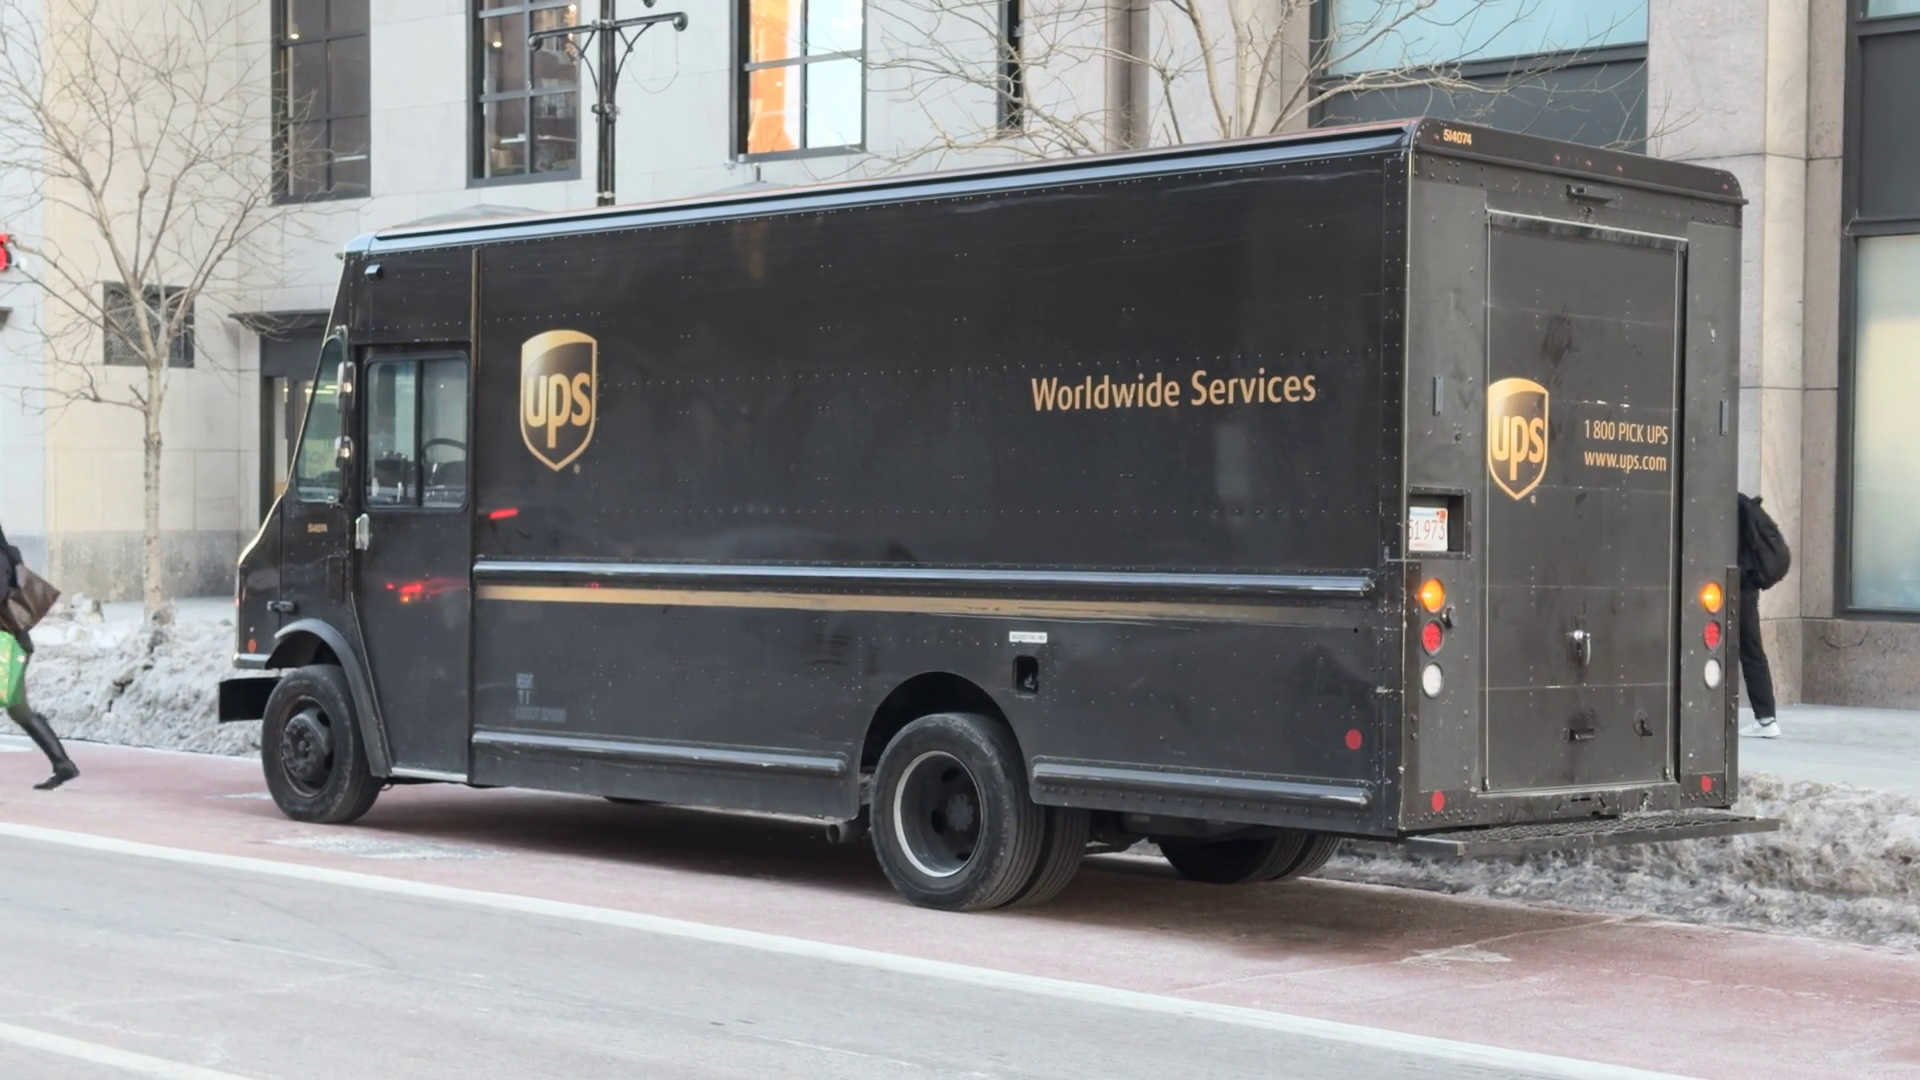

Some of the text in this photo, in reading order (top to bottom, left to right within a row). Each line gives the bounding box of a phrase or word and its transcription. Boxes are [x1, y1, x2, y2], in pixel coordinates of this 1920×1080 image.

[1443, 129, 1472, 145] 514074
[1031, 367, 1317, 411] Worldwide Services
[526, 372, 591, 449] ups
[1492, 416, 1544, 481] ups
[1584, 419, 1669, 445] 1 800 PICK UPS
[1584, 451, 1667, 473] www.ups.com
